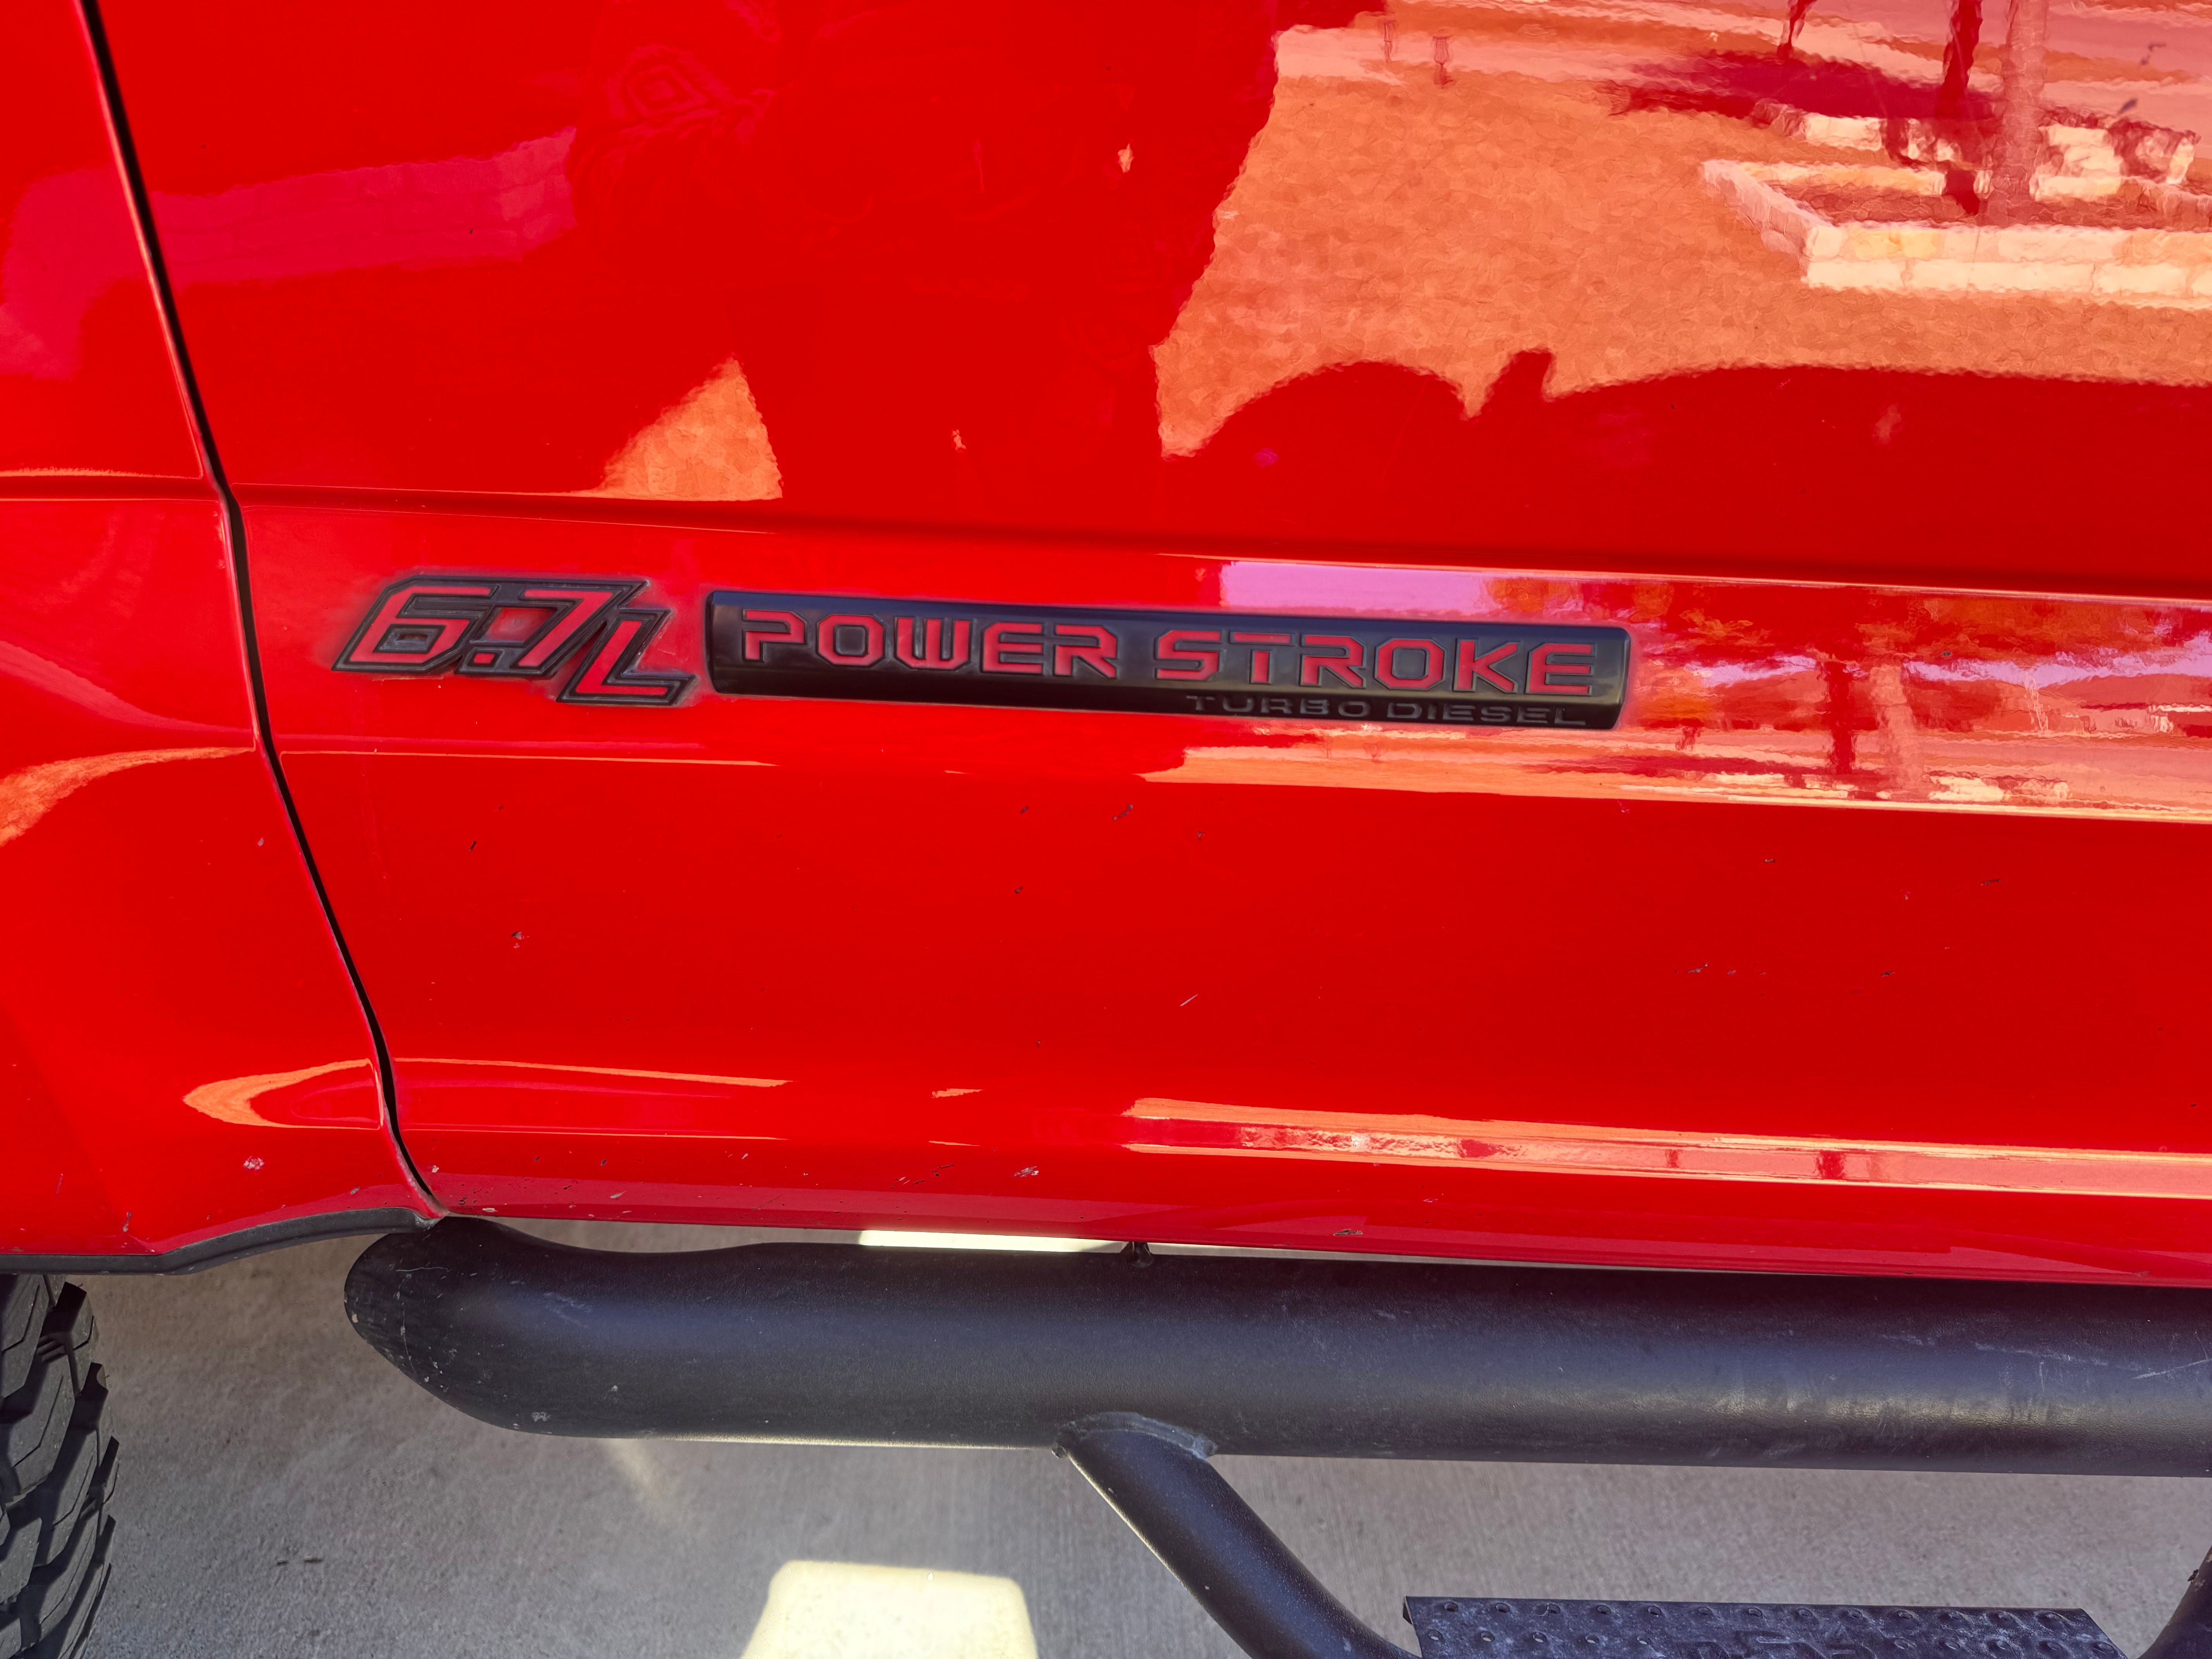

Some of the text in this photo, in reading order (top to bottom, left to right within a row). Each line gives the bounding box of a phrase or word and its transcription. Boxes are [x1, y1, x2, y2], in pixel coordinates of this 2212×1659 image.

[334, 576, 696, 705] 6.7L
[743, 609, 1594, 694] POWER STROKE
[1186, 695, 1586, 725] TURBO DIESEL
